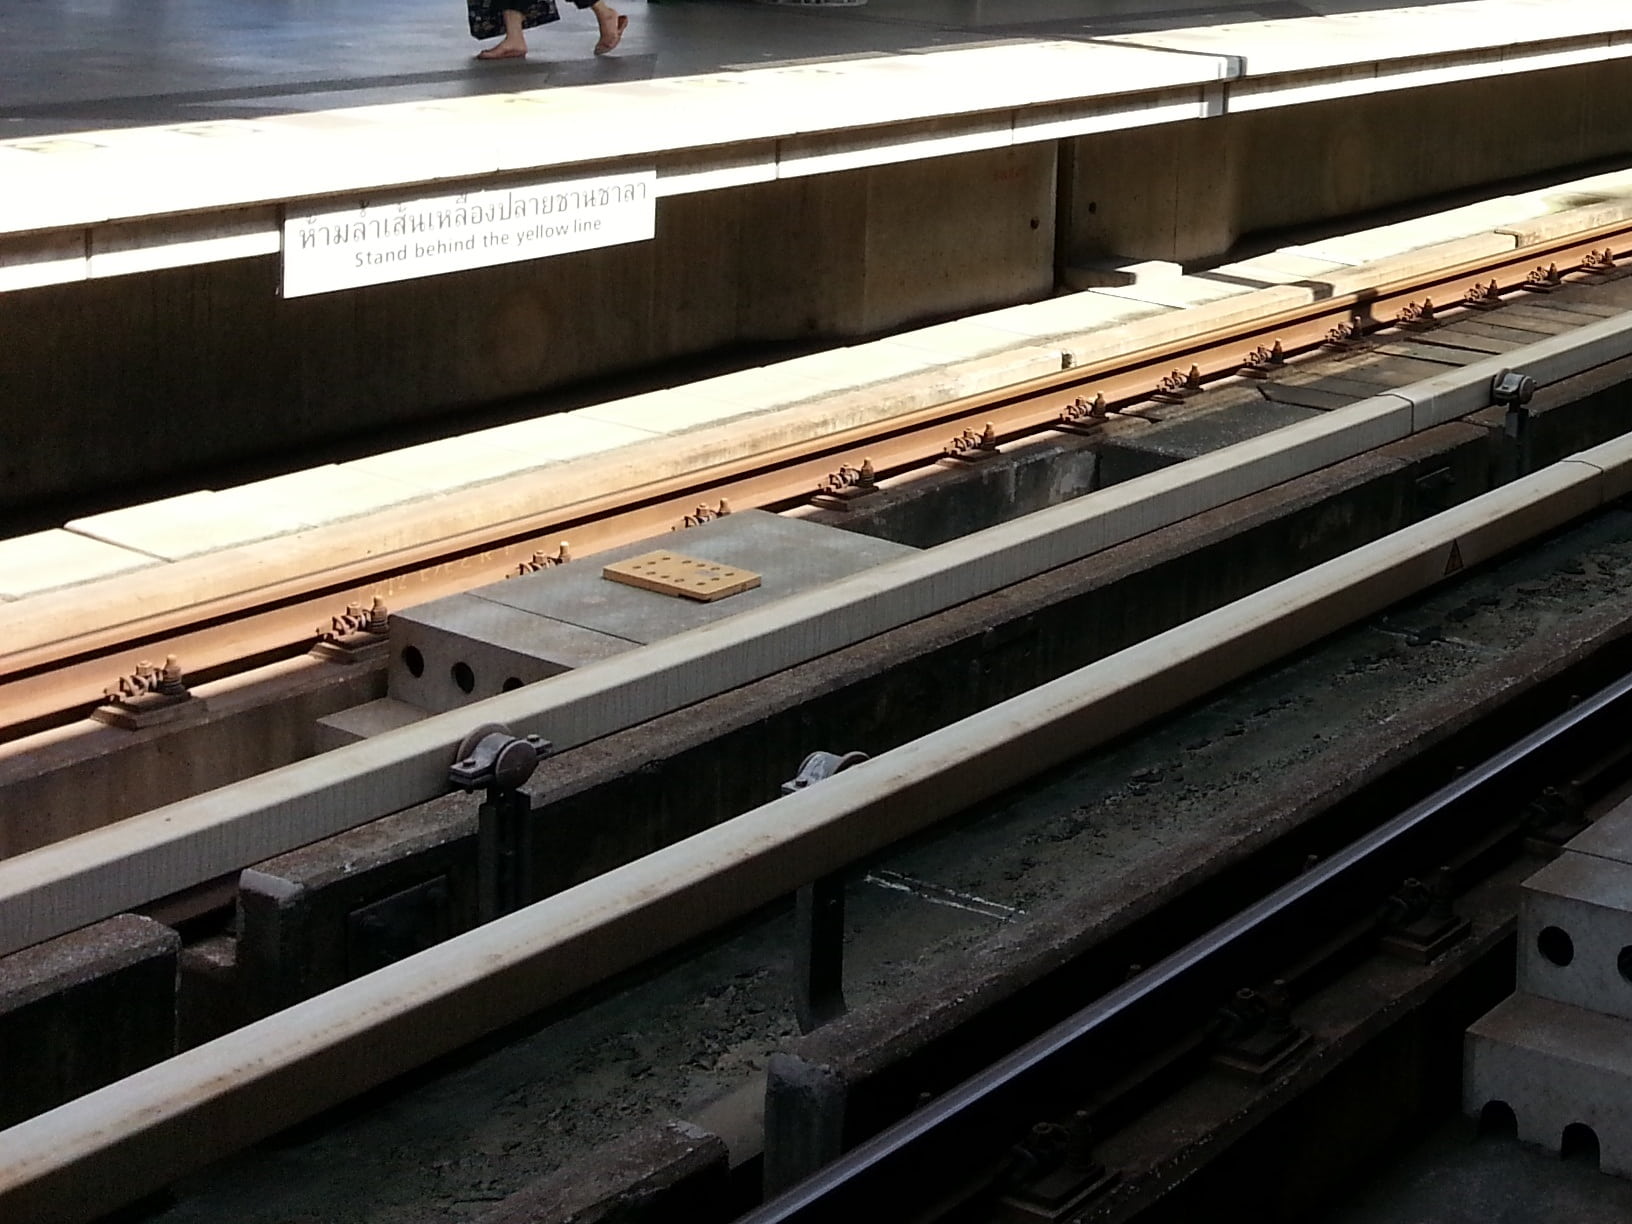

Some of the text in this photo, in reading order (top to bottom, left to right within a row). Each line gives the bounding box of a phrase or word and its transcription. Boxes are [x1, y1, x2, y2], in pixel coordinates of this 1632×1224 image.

[299, 180, 648, 249] ห้ามล้ำเส้นเหลืองปลายชานชาลา
[354, 215, 602, 268] Stand behind the yellow line
